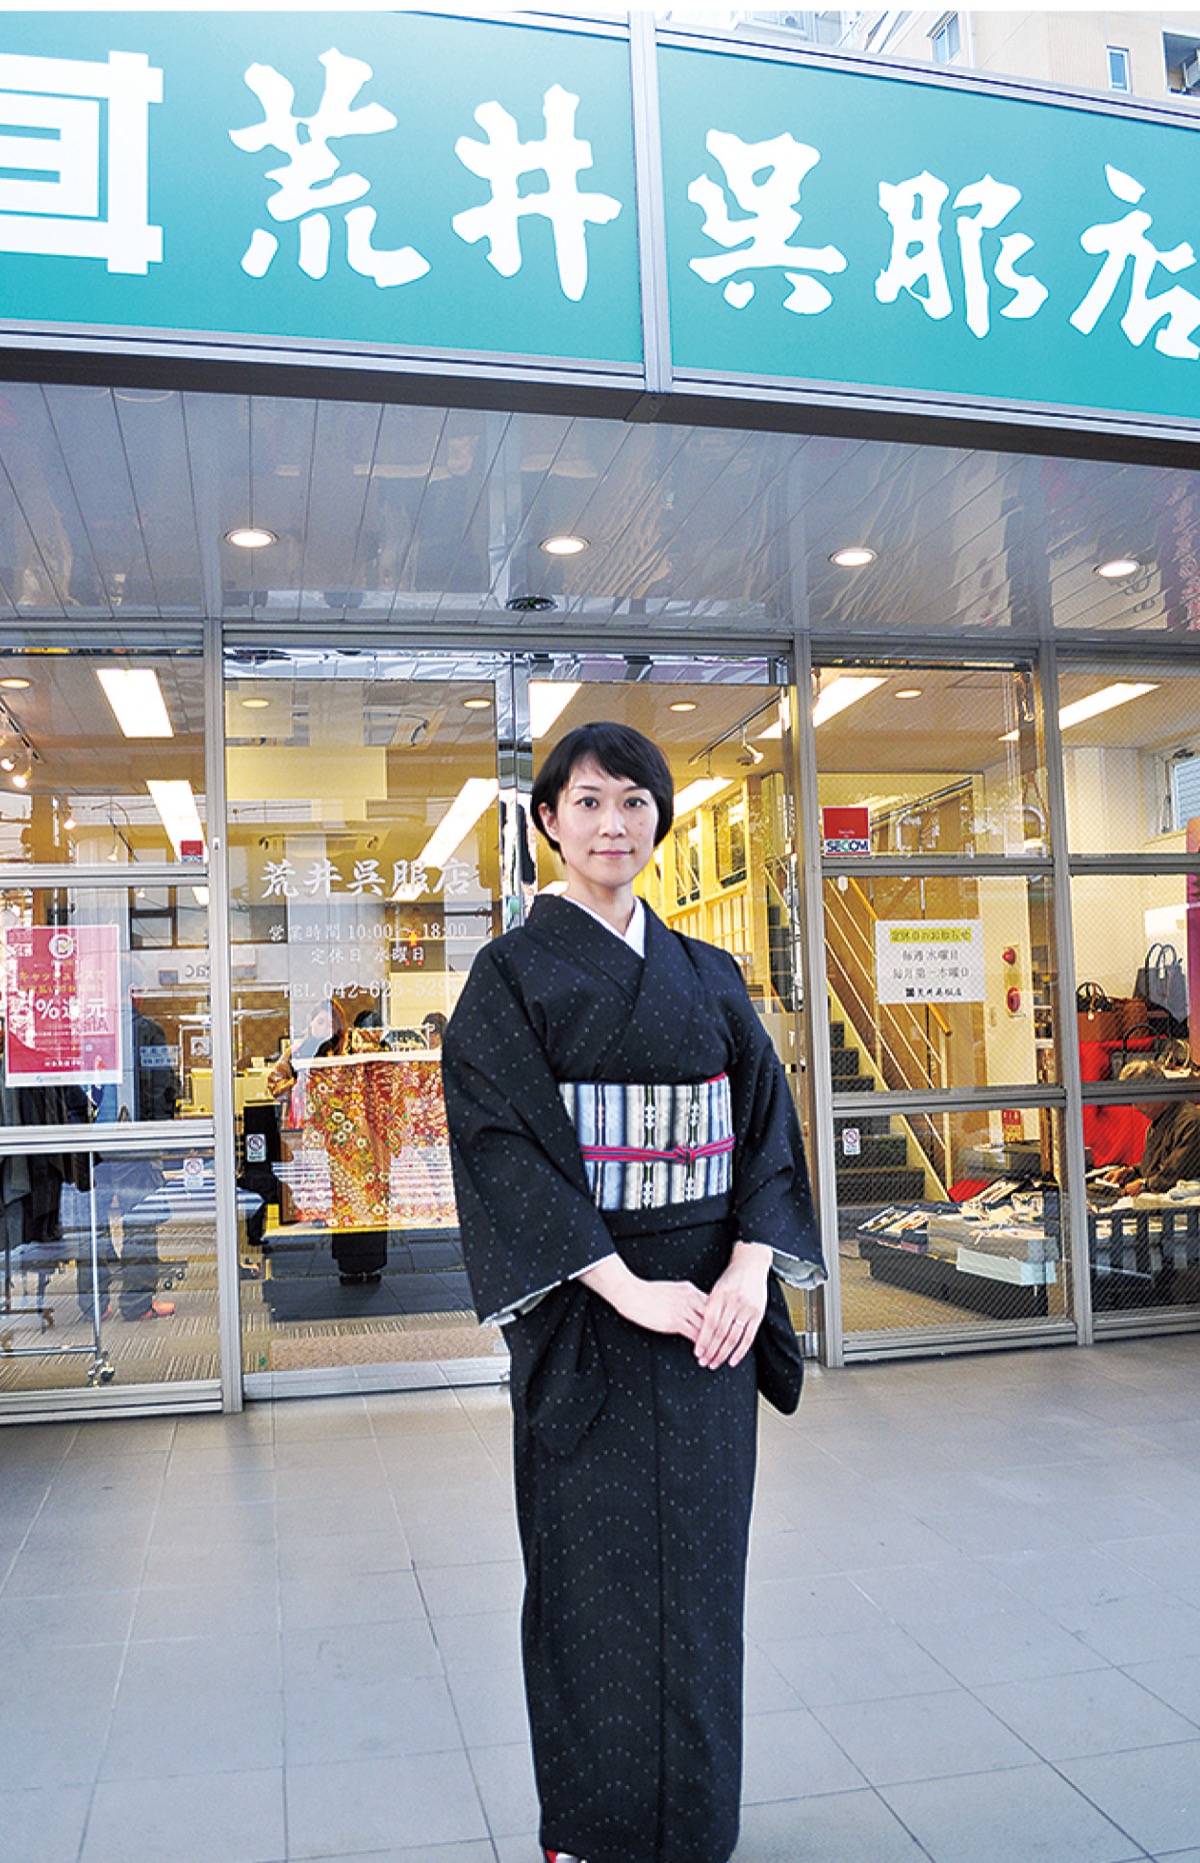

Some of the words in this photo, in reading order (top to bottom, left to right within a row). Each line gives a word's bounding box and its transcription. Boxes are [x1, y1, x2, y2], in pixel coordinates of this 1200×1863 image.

[228, 47, 1200, 361] 荒井呉服店
[826, 839, 869, 852] SECOM
[260, 858, 472, 898] 荒井呉服店
[269, 923, 341, 942] 営業時間
[347, 924, 394, 940] 10:00
[422, 922, 467, 939] 18:00
[311, 947, 361, 965] 定休日
[375, 946, 425, 963] 水曜日
[282, 983, 316, 999] TEL
